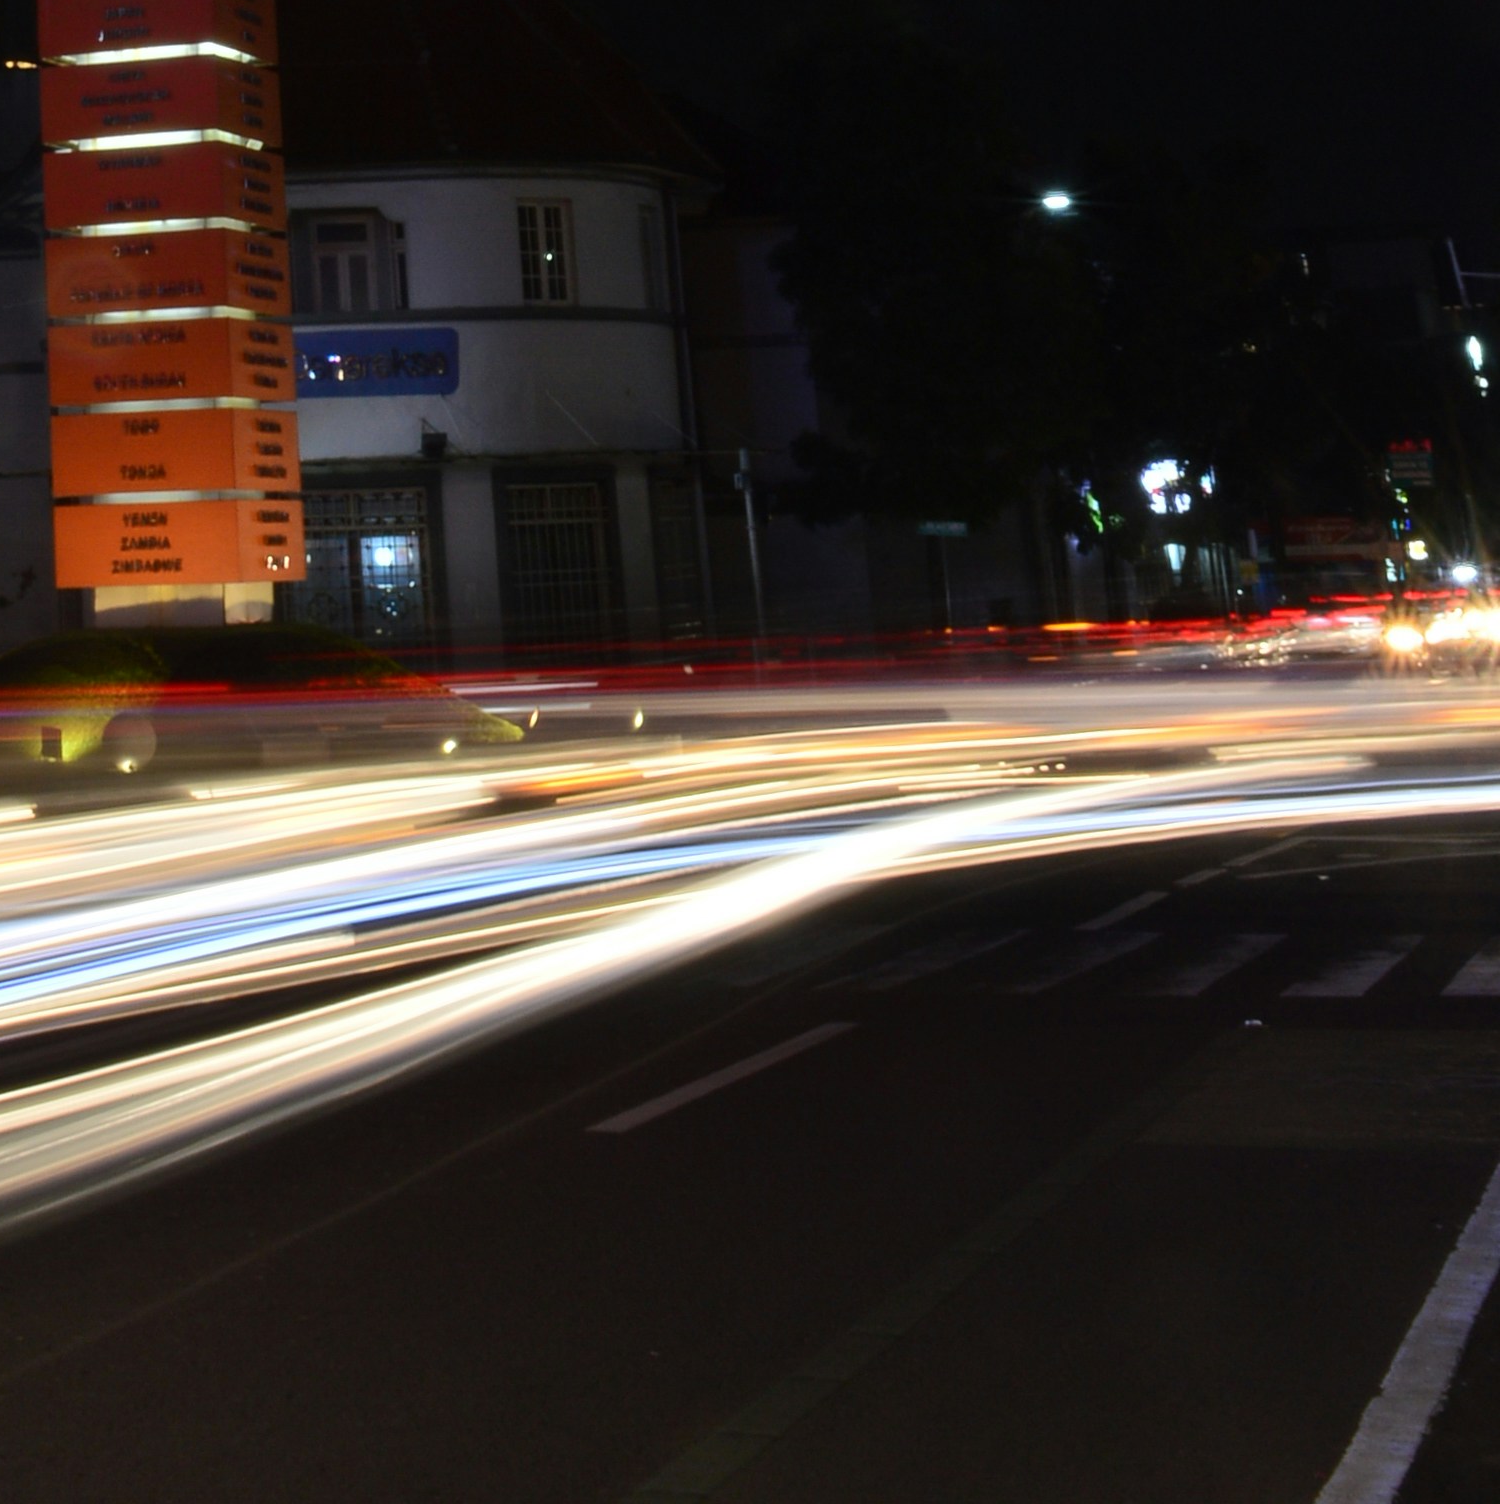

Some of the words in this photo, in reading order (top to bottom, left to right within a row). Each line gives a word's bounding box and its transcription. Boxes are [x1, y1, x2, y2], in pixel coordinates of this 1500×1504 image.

[119, 464, 167, 481] TONGA
[122, 511, 168, 527] YEMEN
[120, 537, 171, 552] ZAMBIA
[111, 557, 183, 574] ZIMBABWE
